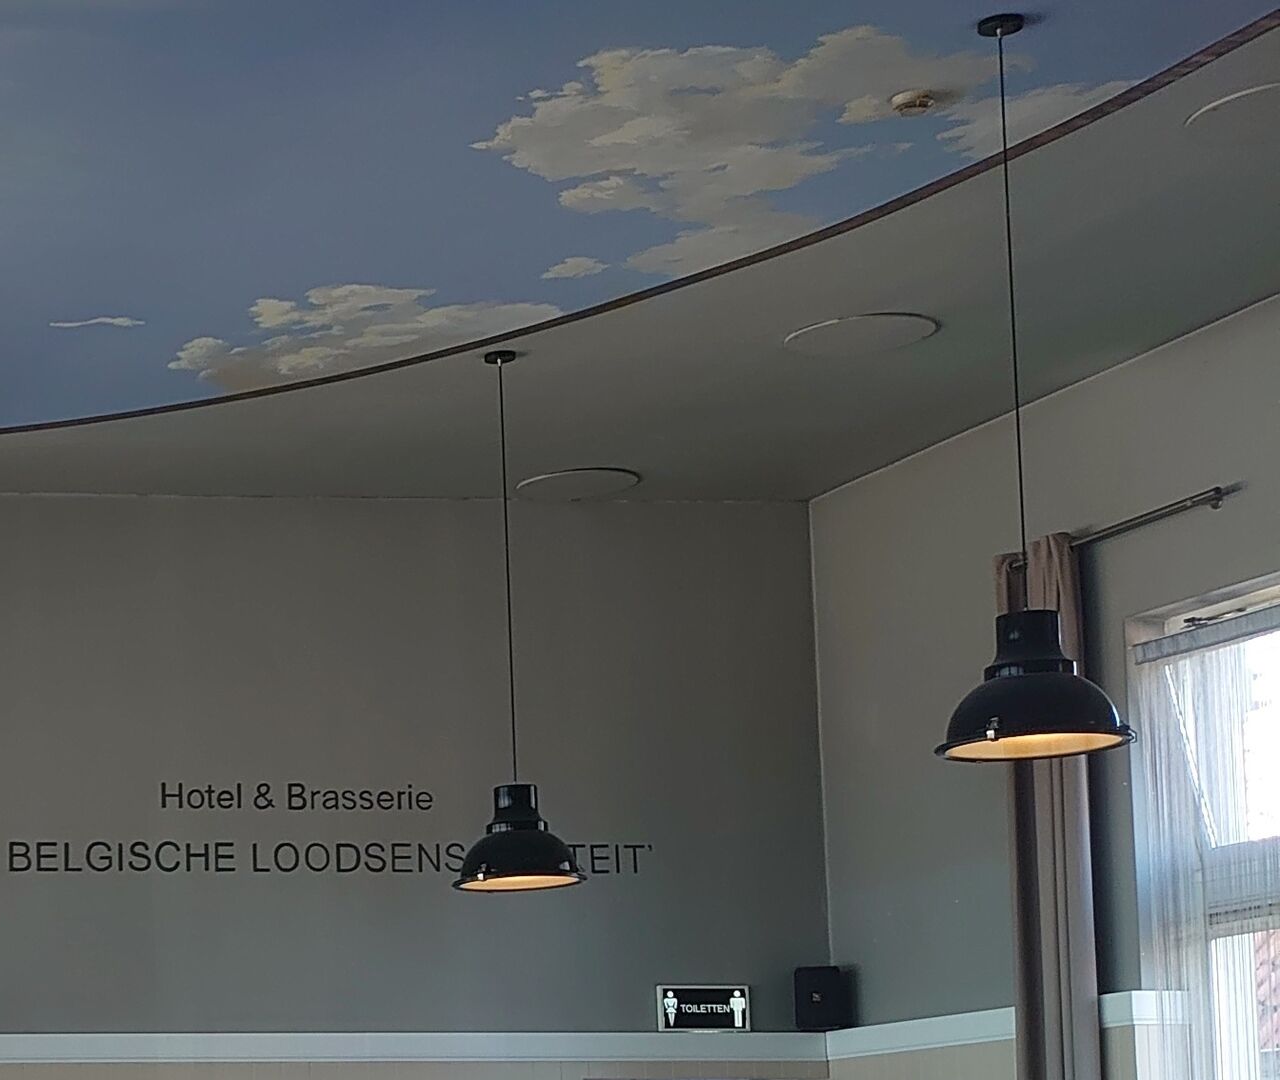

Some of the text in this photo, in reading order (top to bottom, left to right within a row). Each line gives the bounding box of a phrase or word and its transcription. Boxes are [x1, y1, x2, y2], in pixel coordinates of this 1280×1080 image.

[160, 782, 433, 810] Hotel & Brasserie
[8, 841, 236, 872] BELGISCHE
[679, 1003, 731, 1014] TOILETTEN
